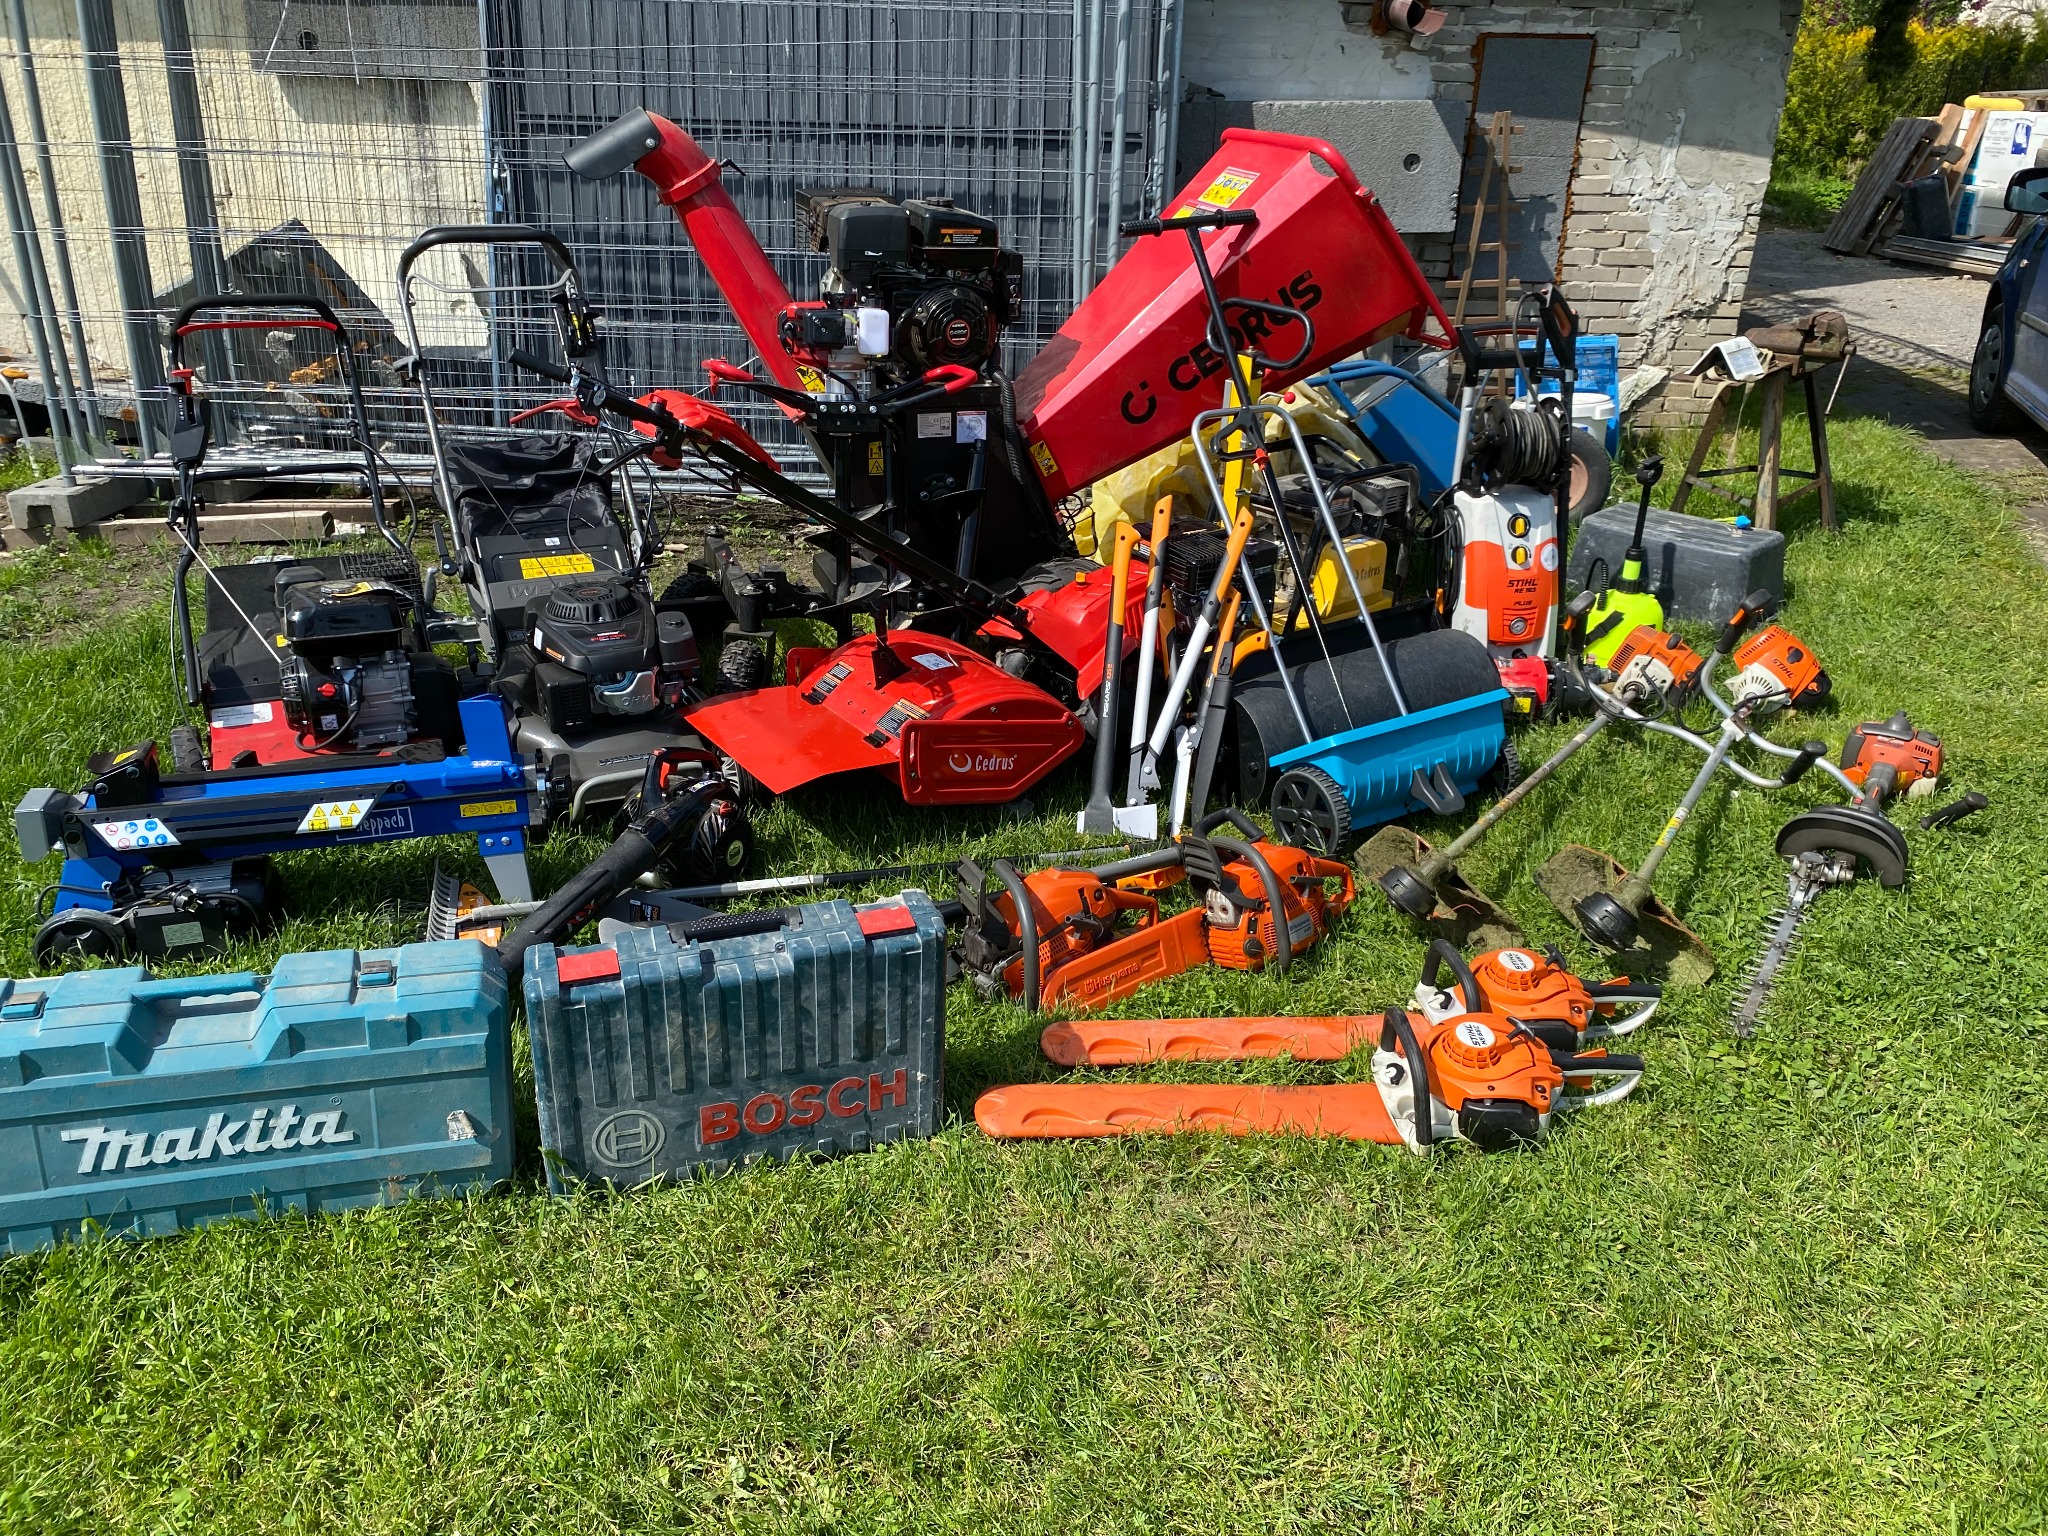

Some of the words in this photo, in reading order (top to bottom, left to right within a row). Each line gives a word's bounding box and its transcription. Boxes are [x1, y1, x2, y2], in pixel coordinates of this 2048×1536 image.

[1507, 579, 1538, 587] STIHL
[1655, 651, 1671, 661] STIHL
[1771, 658, 1794, 679] STIHL
[1103, 680, 1111, 718] FISKARS
[975, 754, 1015, 772] Cedrus
[1504, 952, 1524, 971] STIHL
[1093, 962, 1139, 989] Husqvarna
[1464, 1023, 1482, 1047] STIHL
[700, 1067, 909, 1145] BOSCH
